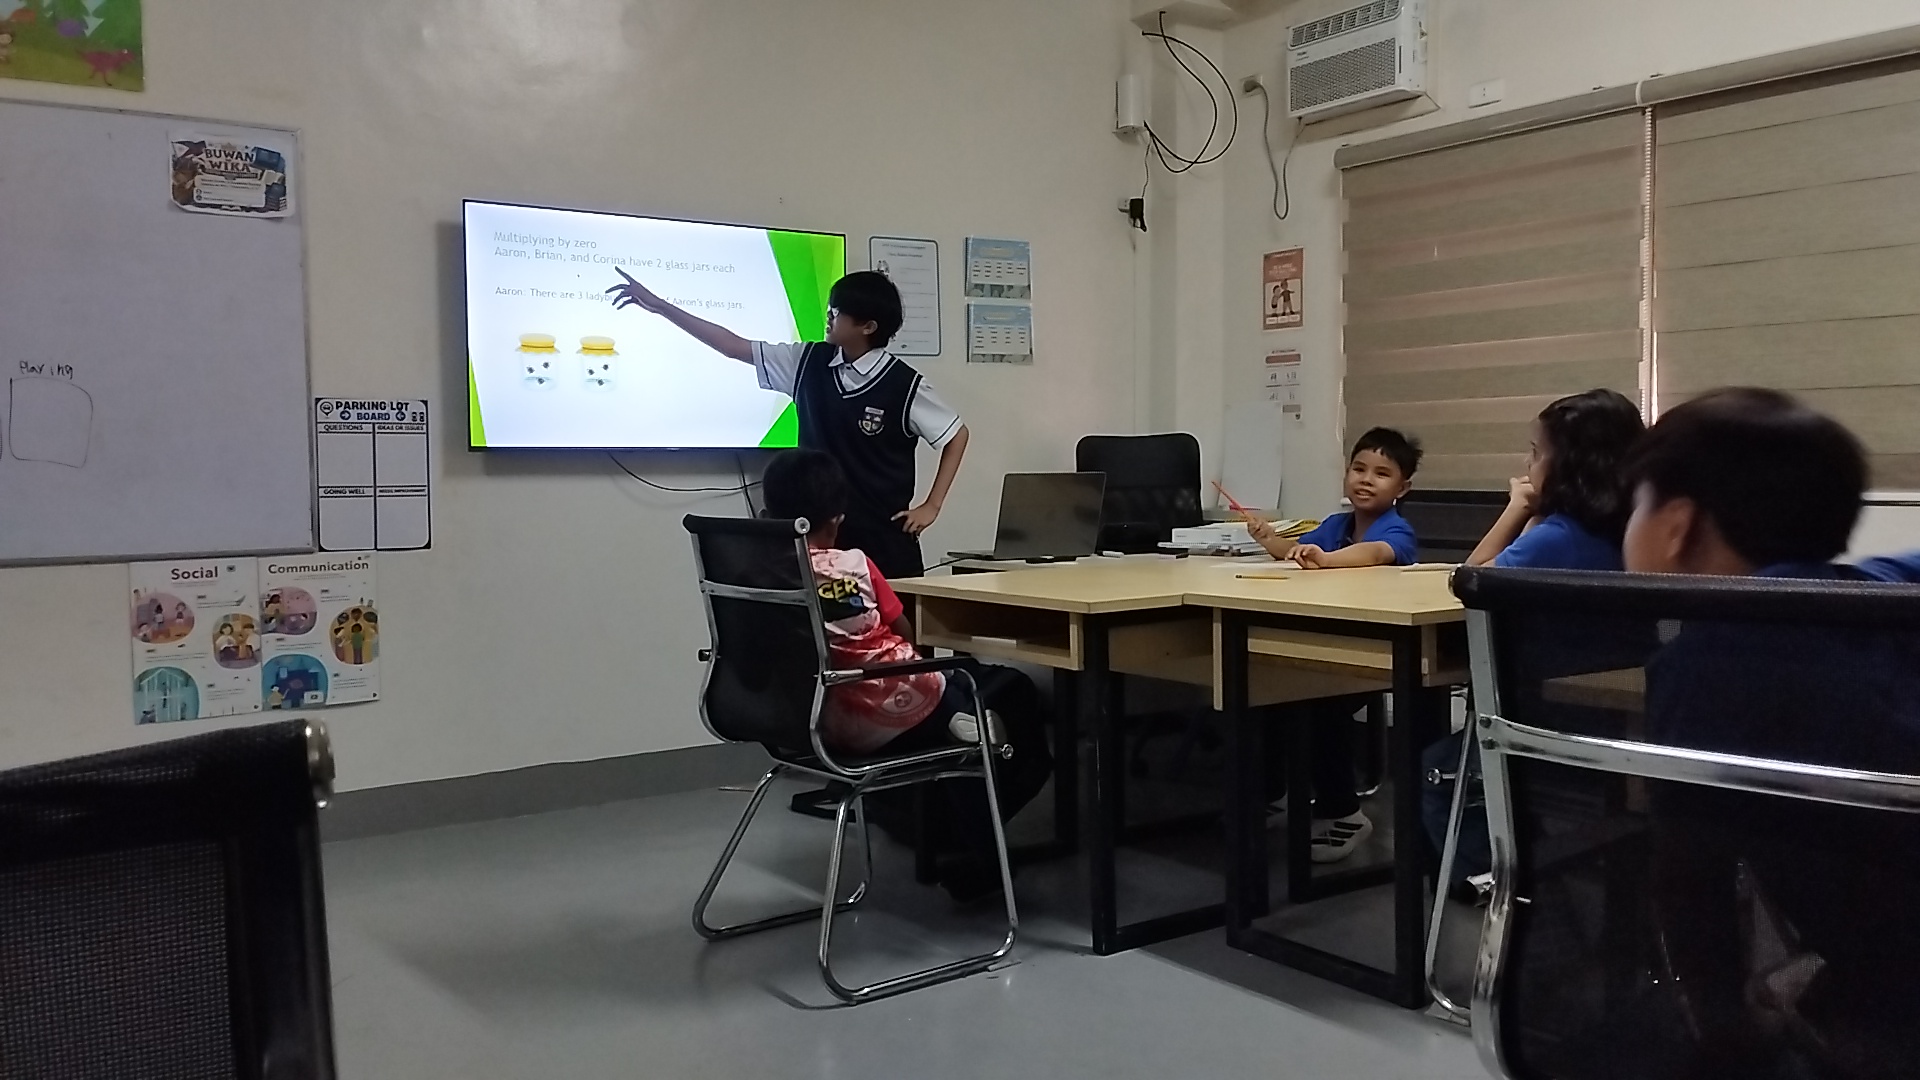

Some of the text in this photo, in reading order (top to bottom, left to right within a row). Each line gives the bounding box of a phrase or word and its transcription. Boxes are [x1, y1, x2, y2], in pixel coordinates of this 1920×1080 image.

[205, 148, 254, 162] BUWAN
[208, 160, 251, 172] WIKA
[493, 231, 597, 249] Multiplying by zero
[494, 246, 736, 273] Aaron, Brian, and Corina have 2 glass jars each
[530, 287, 557, 299] There
[559, 291, 575, 299] are
[577, 291, 583, 300] 3
[672, 297, 703, 307] Aaron's
[705, 299, 725, 310] glass
[335, 401, 410, 411] PARKING LOT
[356, 412, 391, 421] BOARD
[323, 424, 364, 432] QUESTIONS
[171, 565, 219, 581] Social
[267, 560, 370, 575] Communication
[817, 578, 859, 600] GER
